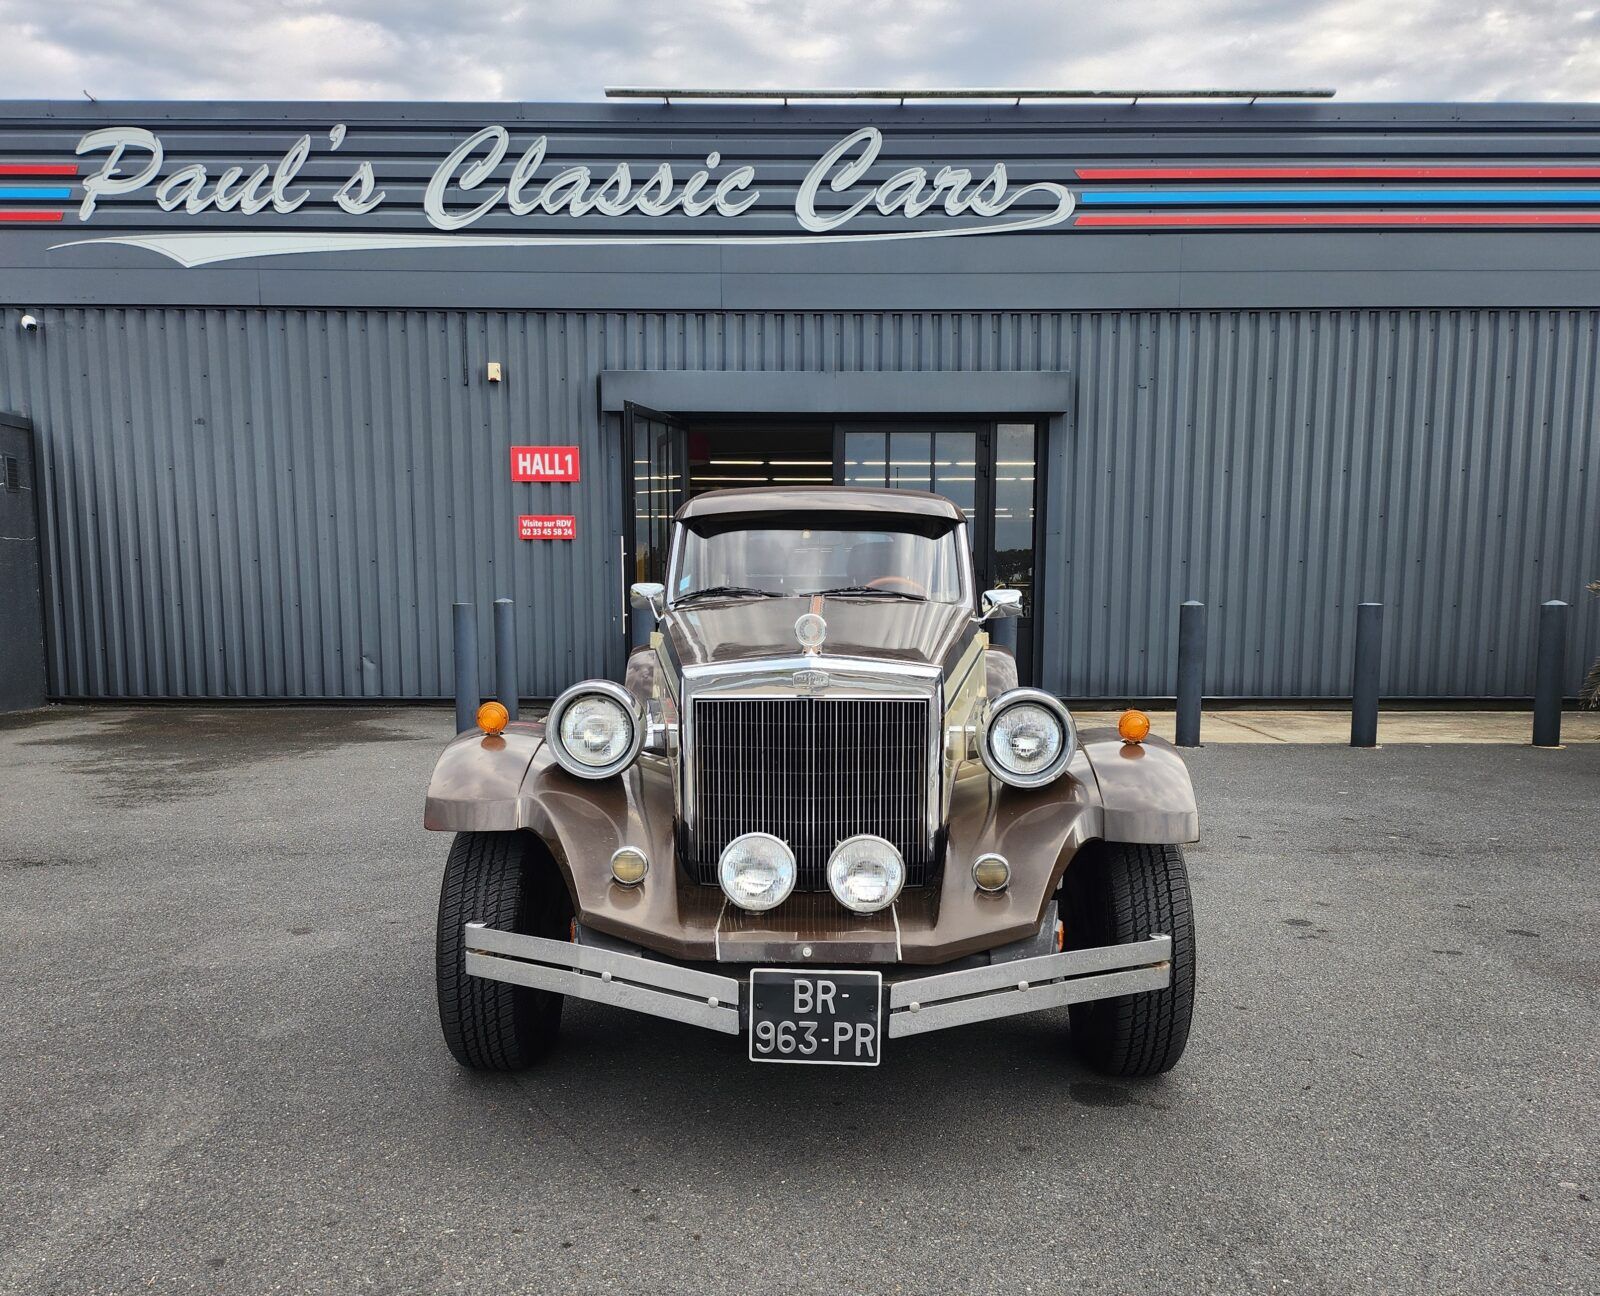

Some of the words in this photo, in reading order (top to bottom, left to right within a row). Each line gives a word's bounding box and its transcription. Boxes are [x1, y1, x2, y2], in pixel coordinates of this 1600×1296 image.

[76, 124, 387, 222] Paul's
[423, 125, 761, 231] Classic
[795, 126, 1009, 232] Cars
[522, 519, 543, 527] Visite
[556, 519, 572, 527] RDV
[755, 1020, 876, 1058] 963-PR
